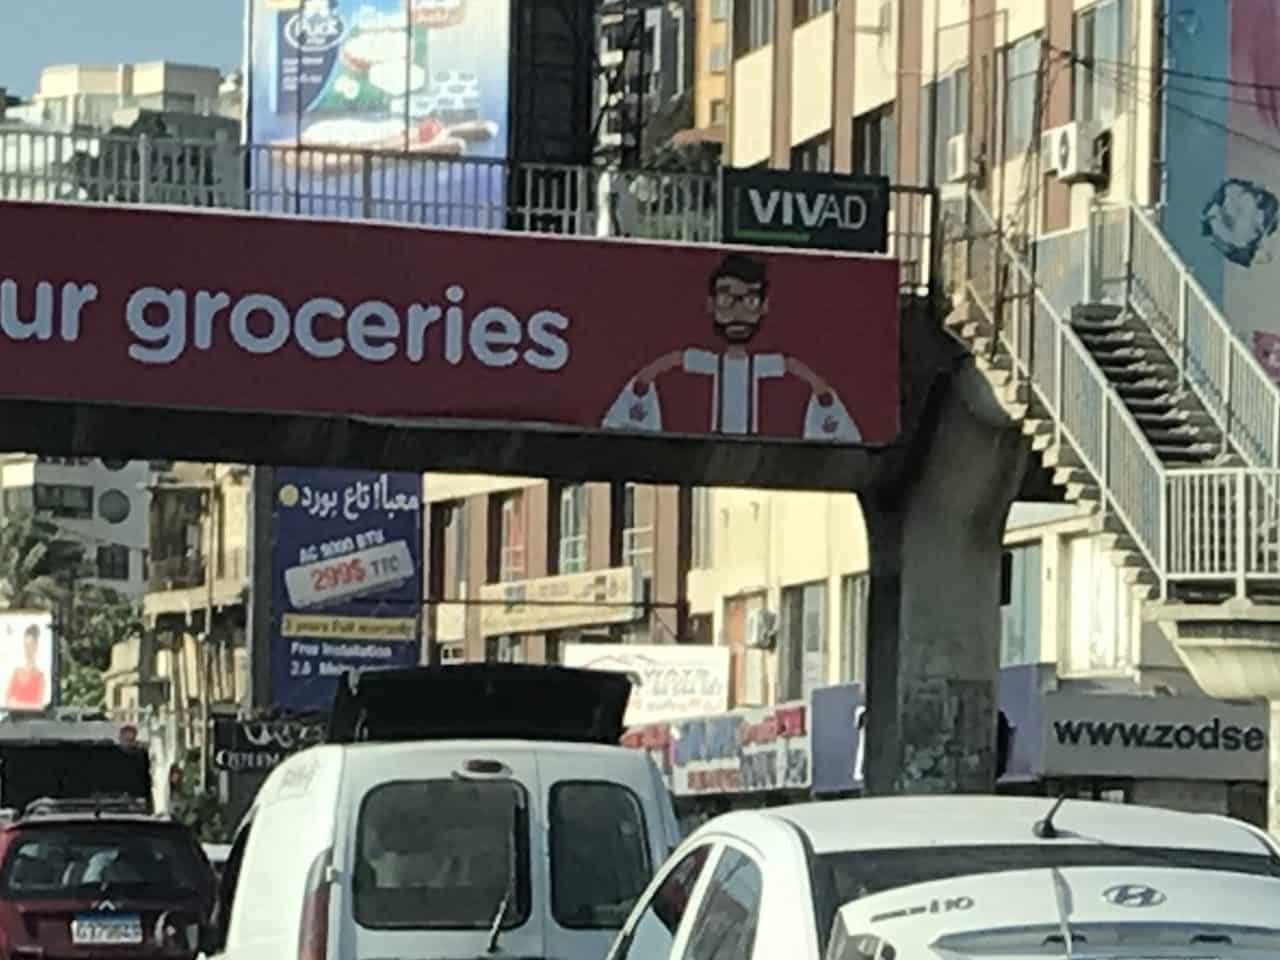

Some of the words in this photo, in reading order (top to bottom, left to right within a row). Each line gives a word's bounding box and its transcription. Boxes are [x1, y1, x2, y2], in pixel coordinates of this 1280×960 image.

[748, 188, 868, 230] VIVAD
[126, 284, 570, 371] groceries
[1052, 716, 1265, 752] www.zodse
